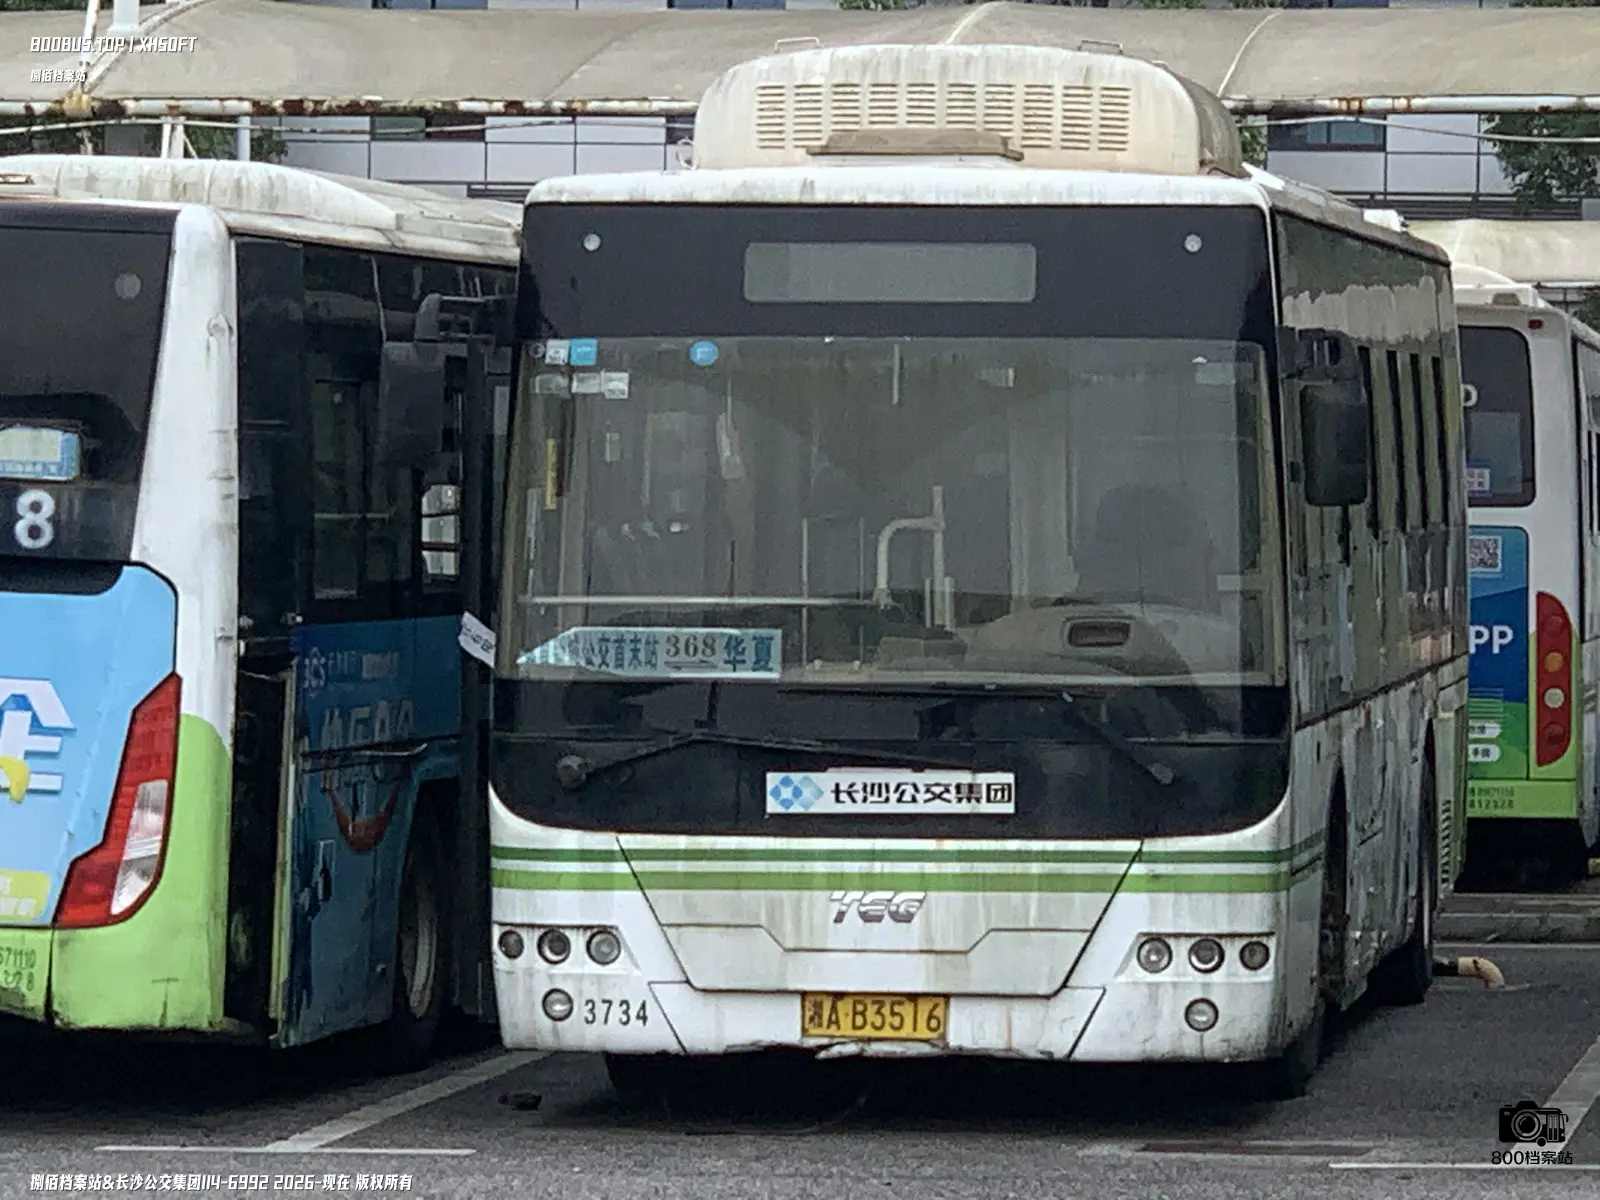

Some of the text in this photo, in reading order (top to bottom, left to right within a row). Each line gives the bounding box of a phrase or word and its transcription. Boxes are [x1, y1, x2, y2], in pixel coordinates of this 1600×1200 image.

[14, 489, 56, 549] 8
[566, 633, 658, 670] 公交首末站
[664, 634, 717, 658] 368
[723, 634, 775, 672] 华夏
[830, 781, 1013, 804] 长沙公交集团
[584, 999, 649, 1026] 3734
